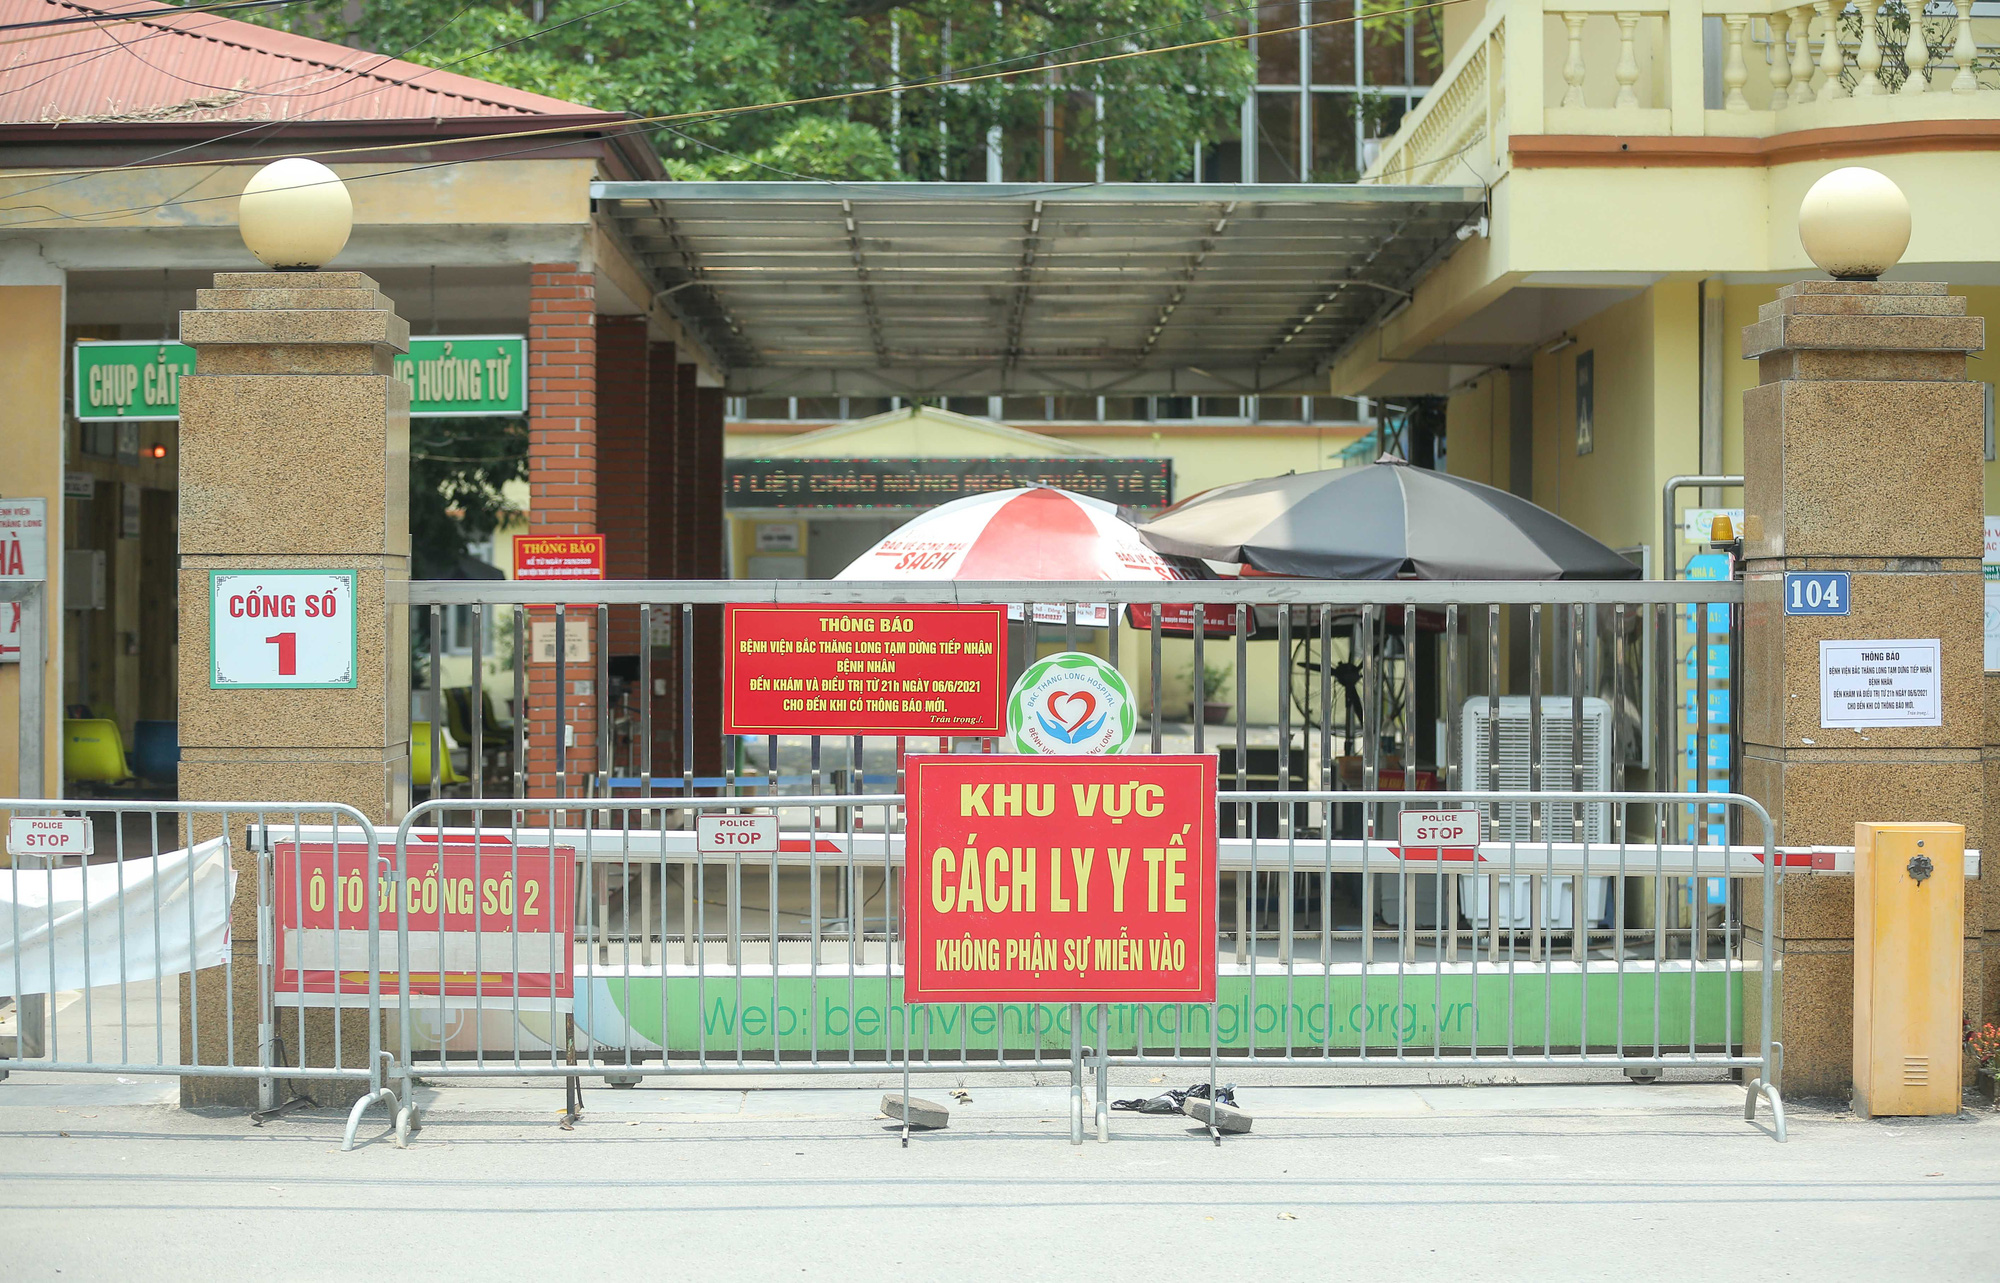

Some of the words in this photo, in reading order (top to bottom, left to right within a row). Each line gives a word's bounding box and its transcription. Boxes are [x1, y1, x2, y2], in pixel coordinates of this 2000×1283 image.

[89, 363, 138, 416] CHỤP
[144, 347, 178, 405] CẮT
[418, 342, 481, 402] HƯỞNG
[486, 347, 511, 400] TỪ
[229, 585, 296, 618] CỔNG
[305, 587, 338, 618] SỐ
[1791, 580, 1839, 608] 104
[819, 615, 875, 632] THÔNG
[880, 615, 914, 632] BÁO
[266, 633, 296, 675] 1
[740, 638, 768, 656] BỆNH
[770, 638, 793, 656] VIỆN
[796, 637, 816, 654] BẮC
[819, 639, 852, 654] THĂNG
[855, 641, 882, 654] LONG
[884, 641, 906, 656] TẠM
[908, 639, 937, 655] DỪNG
[939, 638, 961, 654] TIẾP
[963, 640, 993, 657] NHẬN
[1861, 651, 1884, 661] THÔNG
[1886, 651, 1900, 661] BÁO
[836, 658, 864, 675] BỆNH
[867, 658, 896, 673] NHÂN
[749, 674, 771, 691] ĐẾN
[773, 676, 803, 691] KHÁM
[806, 676, 819, 691] VÀ
[821, 675, 845, 691] ĐIỀU
[847, 679, 863, 694] TRỊ
[866, 677, 880, 692] TỪ
[881, 680, 900, 692] 21h
[902, 677, 929, 692] NGÀY
[932, 680, 981, 693] 06/6/2021
[1028, 691, 1039, 707] BAC
[1037, 674, 1062, 692] THANG
[1064, 672, 1085, 681] LONG
[1087, 677, 1116, 707] HOSPITAL
[783, 698, 804, 711] CHO
[806, 695, 827, 711] ĐẾN
[829, 699, 847, 711] KHI
[849, 697, 863, 711] CÓ
[866, 697, 899, 712] THÔNG
[902, 697, 922, 712] BÁO
[925, 696, 948, 712] MỚI.
[930, 715, 951, 723] Trân
[1100, 728, 1114, 749] LONG
[960, 783, 1055, 817] KHU
[1071, 781, 1165, 824] VỰC
[26, 834, 69, 846] STOP
[714, 832, 761, 845] STOP
[1417, 827, 1463, 839] STOP
[931, 833, 1037, 913] CÁCH
[1050, 847, 1095, 913] LY
[1107, 847, 1131, 913] Y
[1143, 823, 1192, 913] TẾ
[309, 868, 326, 912] Ô
[337, 868, 364, 913] TÔ
[406, 863, 474, 915] CỔNG
[523, 880, 540, 916] 2
[936, 931, 1000, 971] KHÔNG
[1006, 931, 1058, 978] PHẬN
[1063, 935, 1091, 978] SỰ
[1094, 926, 1143, 971] MIỄN
[1149, 932, 1185, 971] VÀO
[704, 997, 808, 1036] Web:
[825, 994, 1480, 1044] benhvenbacthanglong.org.vn
